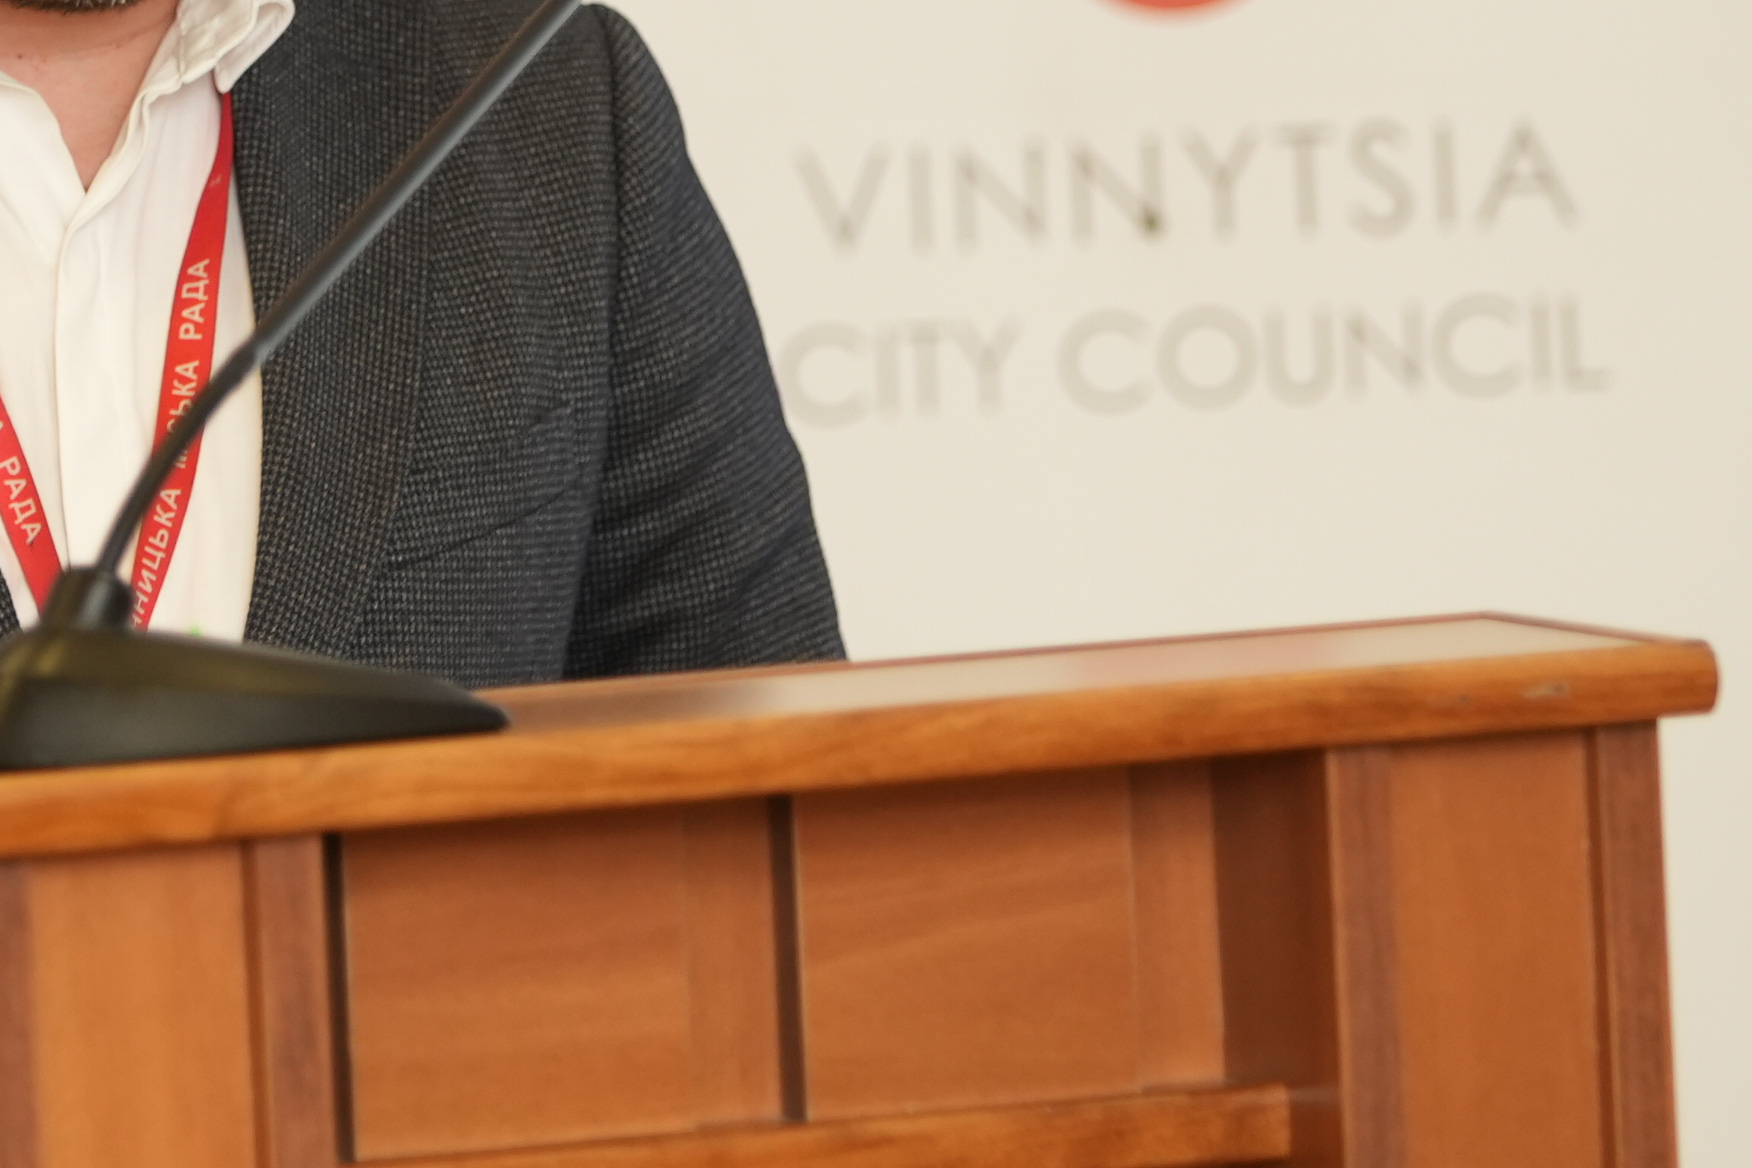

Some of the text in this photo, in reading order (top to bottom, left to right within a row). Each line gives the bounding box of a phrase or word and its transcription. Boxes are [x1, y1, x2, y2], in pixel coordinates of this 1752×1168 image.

[793, 117, 1578, 253] VINNYTSIA
[178, 258, 210, 341] РАДА
[778, 292, 1610, 430] CITY COUNCIL
